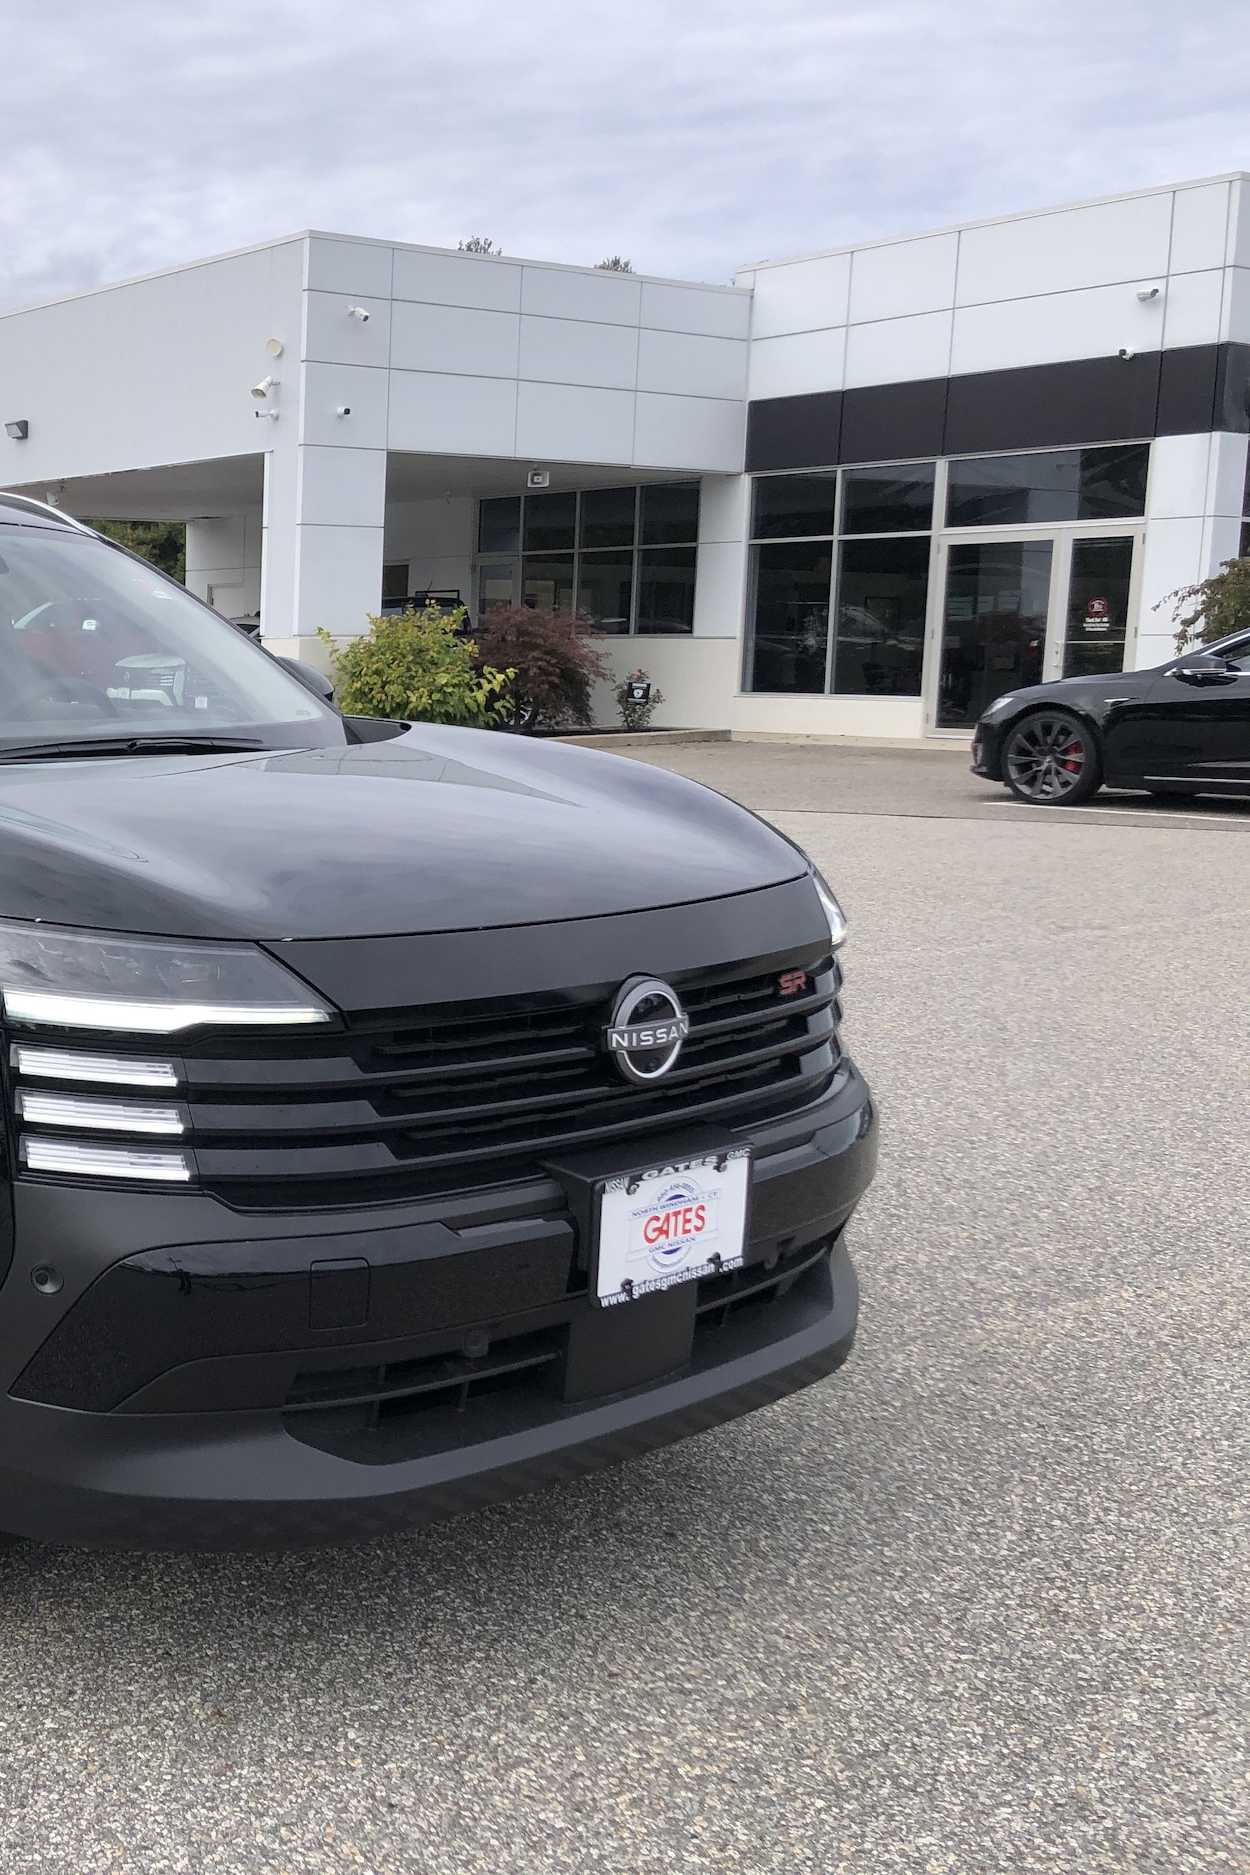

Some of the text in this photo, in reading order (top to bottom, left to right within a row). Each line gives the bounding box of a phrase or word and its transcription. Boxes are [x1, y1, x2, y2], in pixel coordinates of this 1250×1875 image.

[780, 971, 806, 995] SR
[611, 1020, 689, 1048] NISSAN
[726, 1148, 751, 1161] GMC
[641, 1155, 719, 1180] GATES
[643, 1204, 707, 1245] GATES
